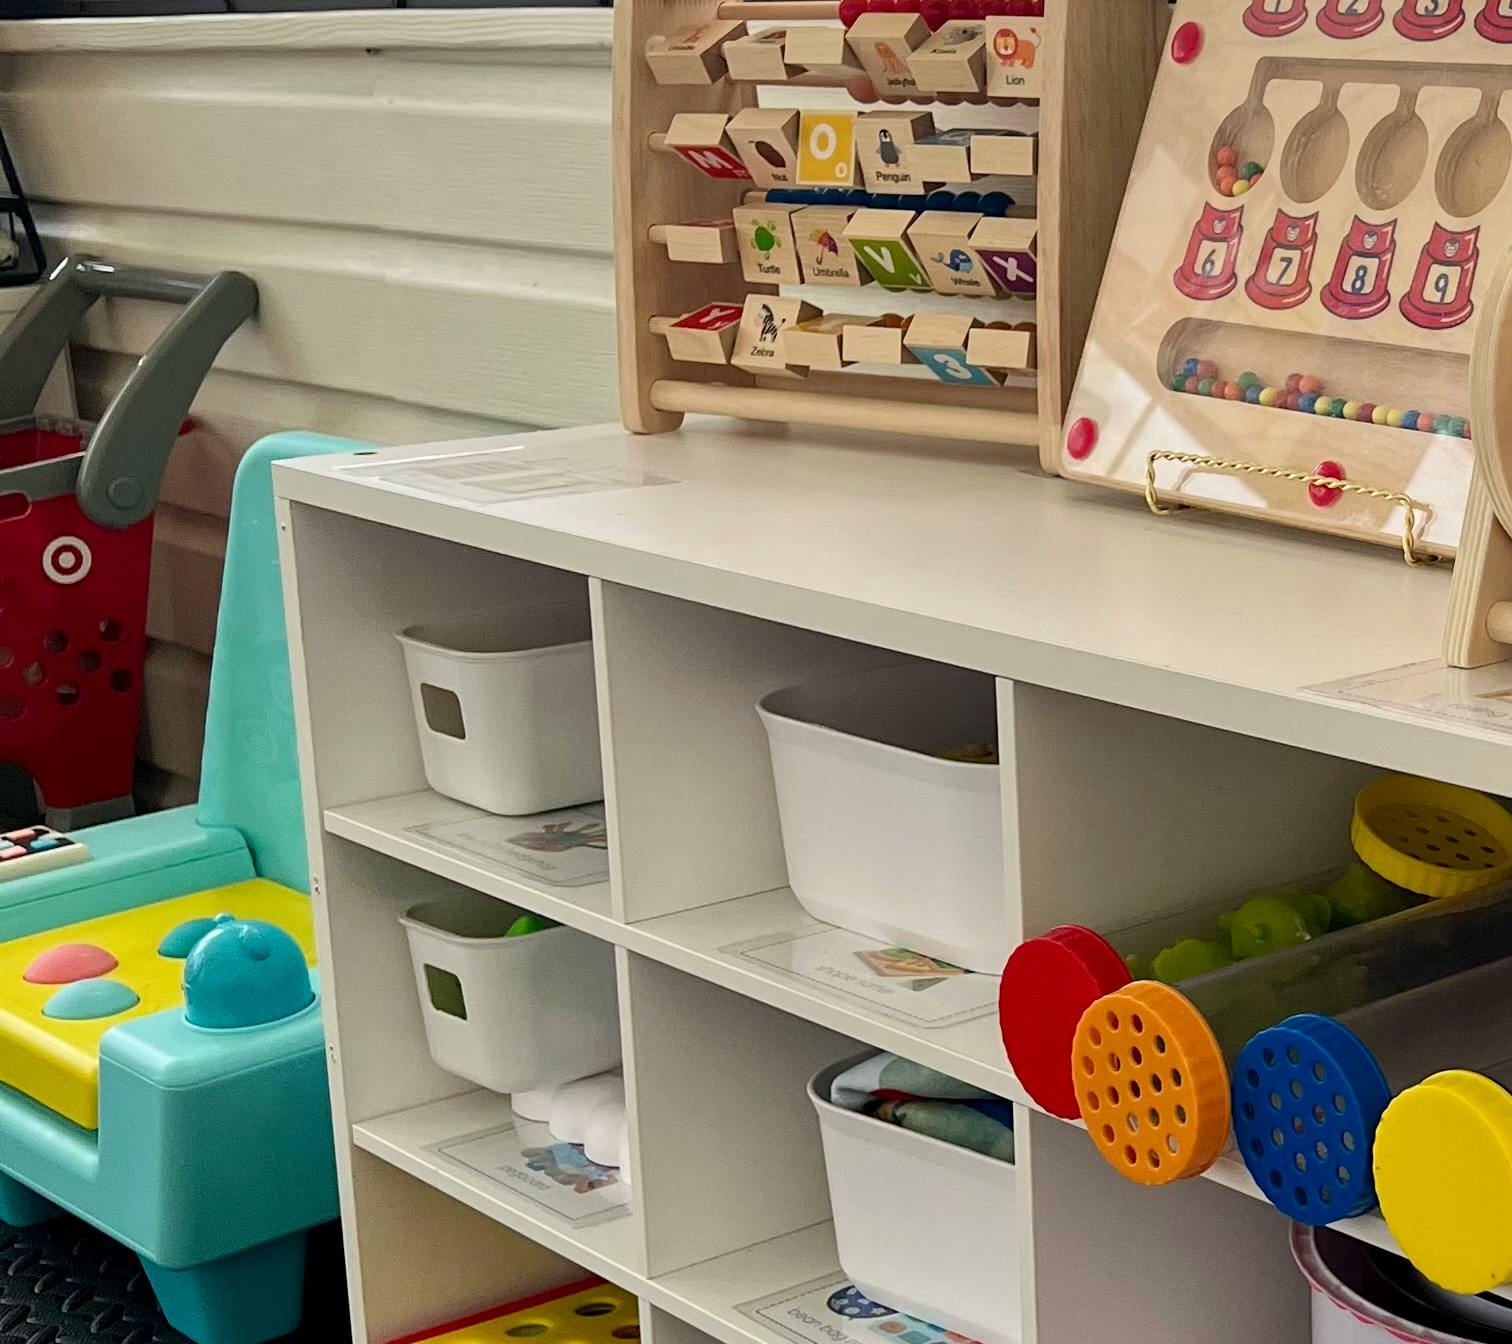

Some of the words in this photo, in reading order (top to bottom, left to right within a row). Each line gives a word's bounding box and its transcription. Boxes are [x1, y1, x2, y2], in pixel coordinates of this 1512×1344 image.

[1006, 74, 1025, 86] Lion
[875, 171, 911, 183] Penguin
[863, 246, 895, 273] V
[757, 263, 781, 275] Turtle
[812, 267, 849, 278] Umbrella
[1202, 249, 1216, 278] 6
[1276, 257, 1293, 285] 7
[1351, 265, 1367, 294] 8
[1434, 273, 1449, 305] 9
[750, 346, 775, 358] Zebra
[934, 353, 973, 380] 3
[788, 1308, 820, 1328] bean
[820, 1324, 848, 1342] bag
